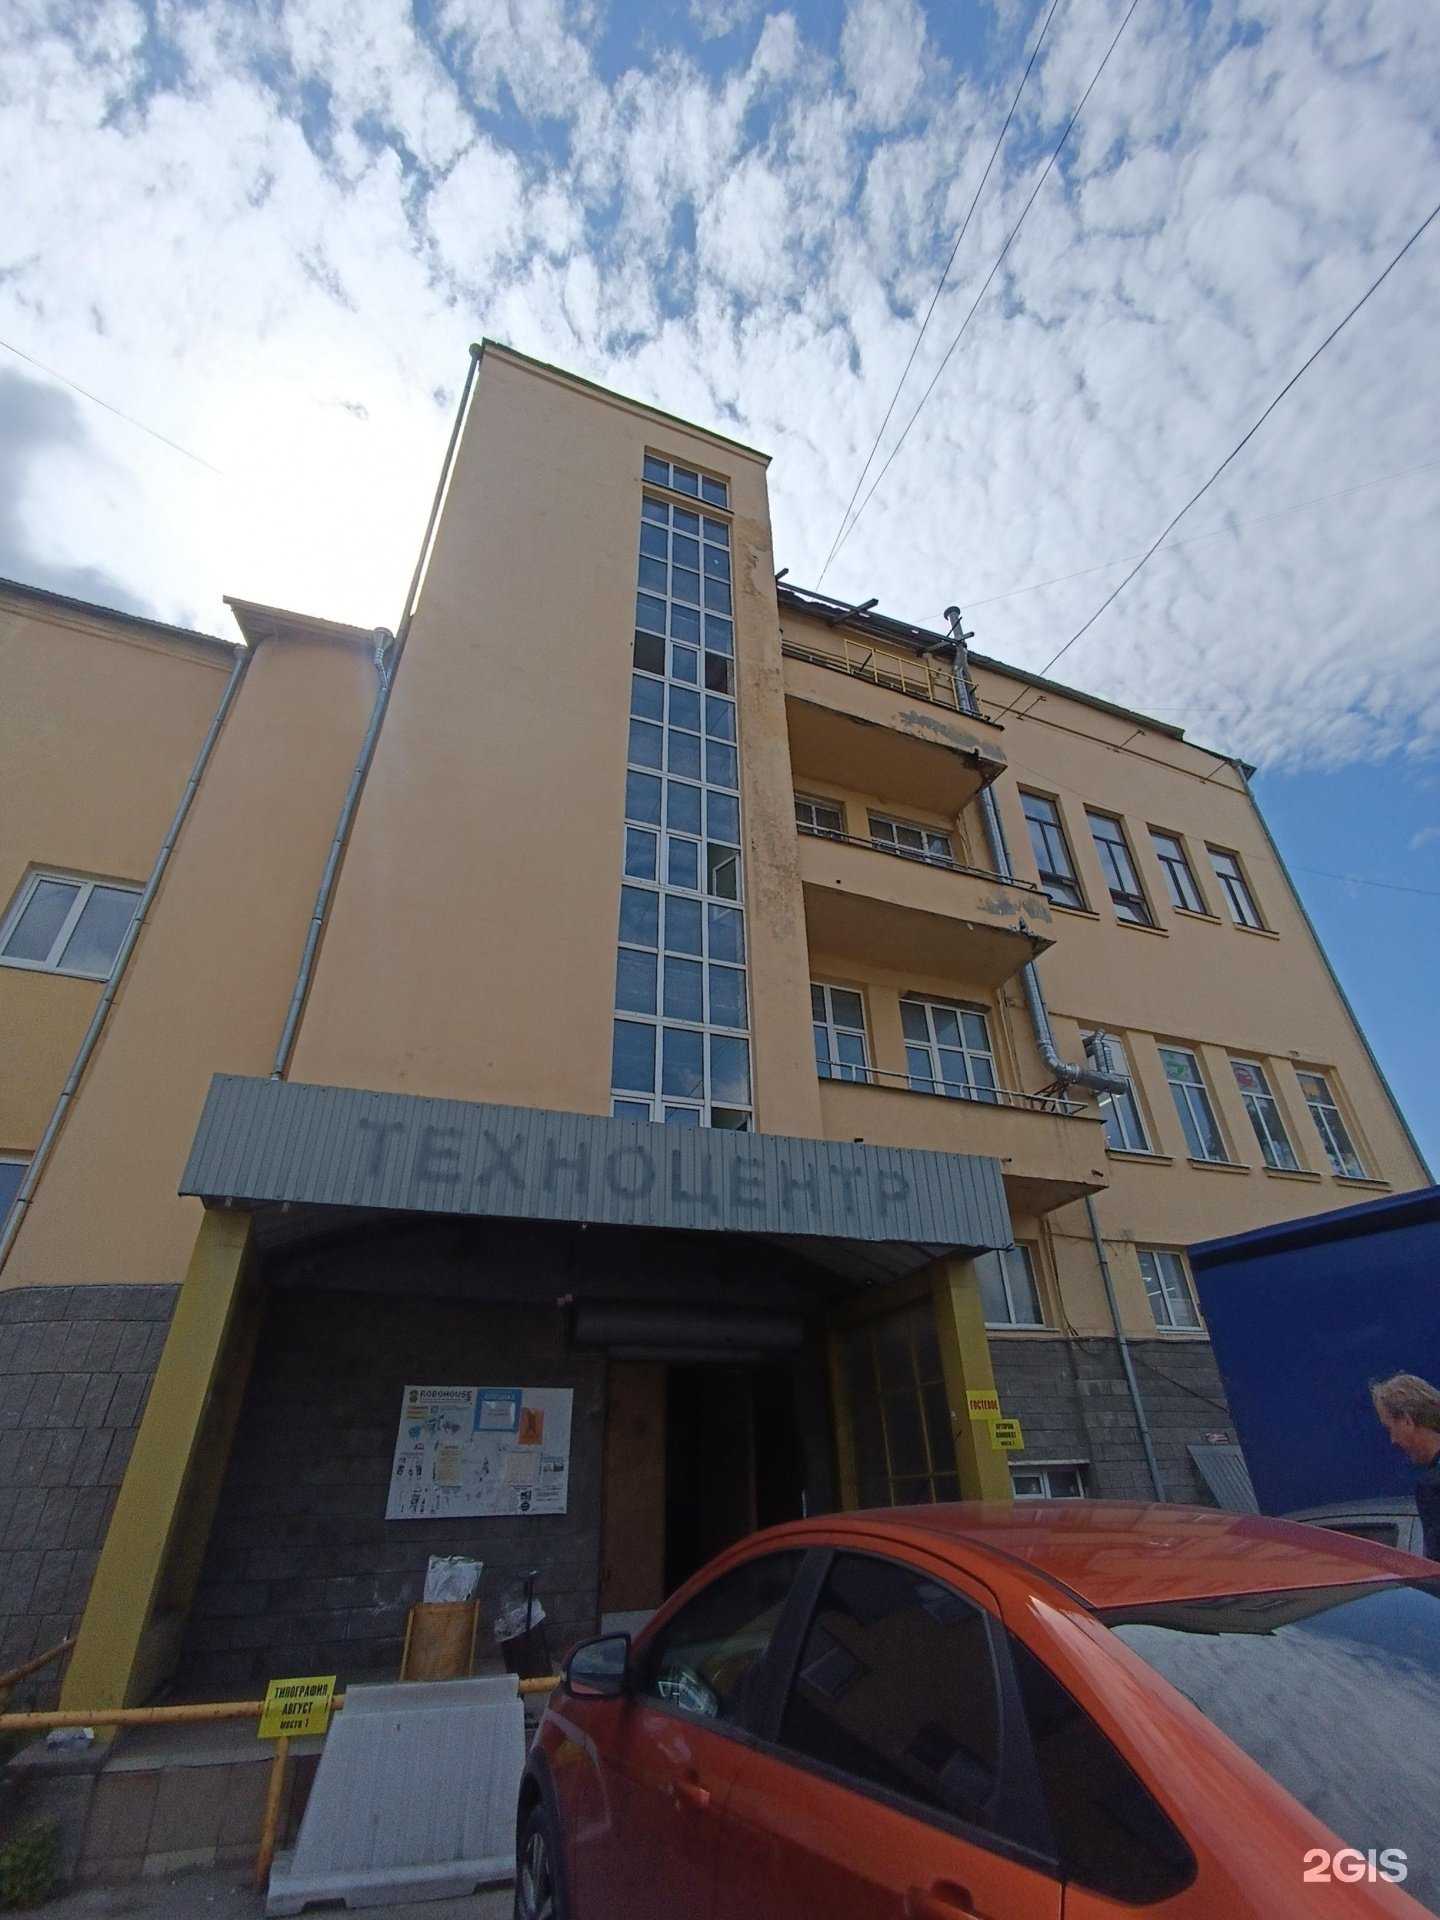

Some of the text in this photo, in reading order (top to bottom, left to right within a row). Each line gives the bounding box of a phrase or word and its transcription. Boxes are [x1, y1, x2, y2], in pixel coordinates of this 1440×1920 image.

[360, 1116, 911, 1217] ТЕХНОЦЕНТР
[274, 1684, 328, 1699] ТИПОГРАФИЯ
[281, 1701, 313, 1715] АВГУСТ
